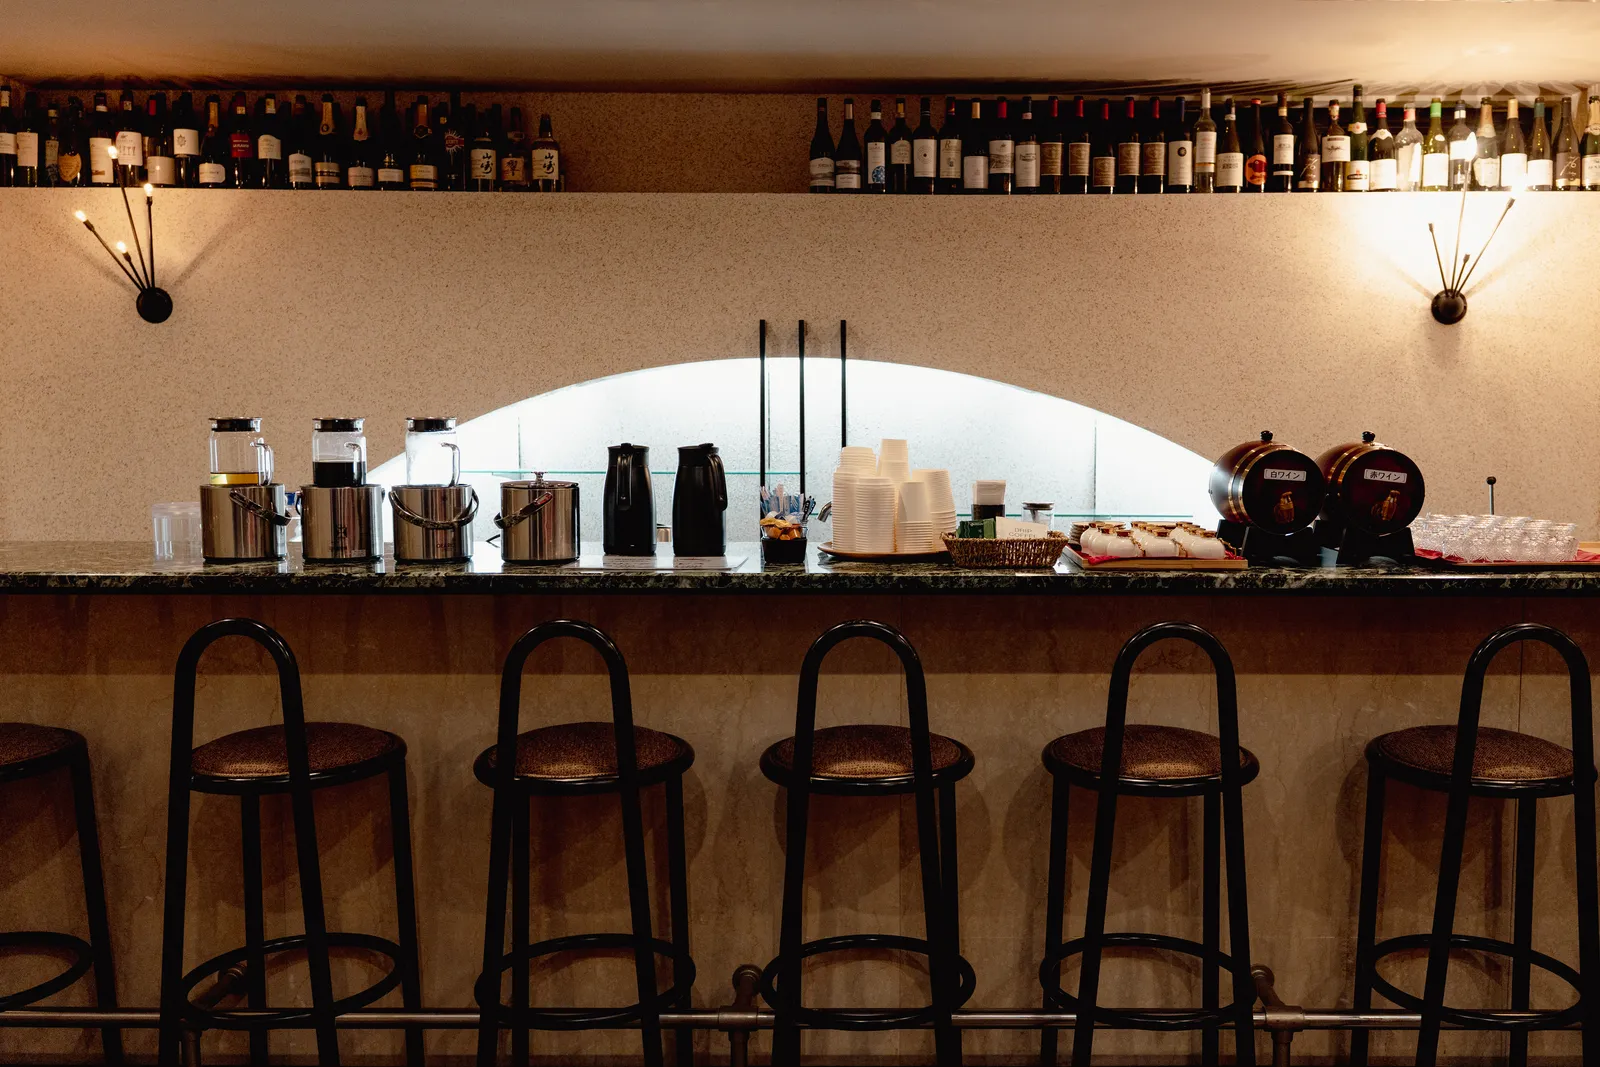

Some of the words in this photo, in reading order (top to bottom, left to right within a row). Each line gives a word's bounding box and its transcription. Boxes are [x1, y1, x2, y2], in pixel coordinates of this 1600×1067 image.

[1270, 470, 1300, 480] 白ワイン
[1370, 470, 1401, 481] 赤ワイン
